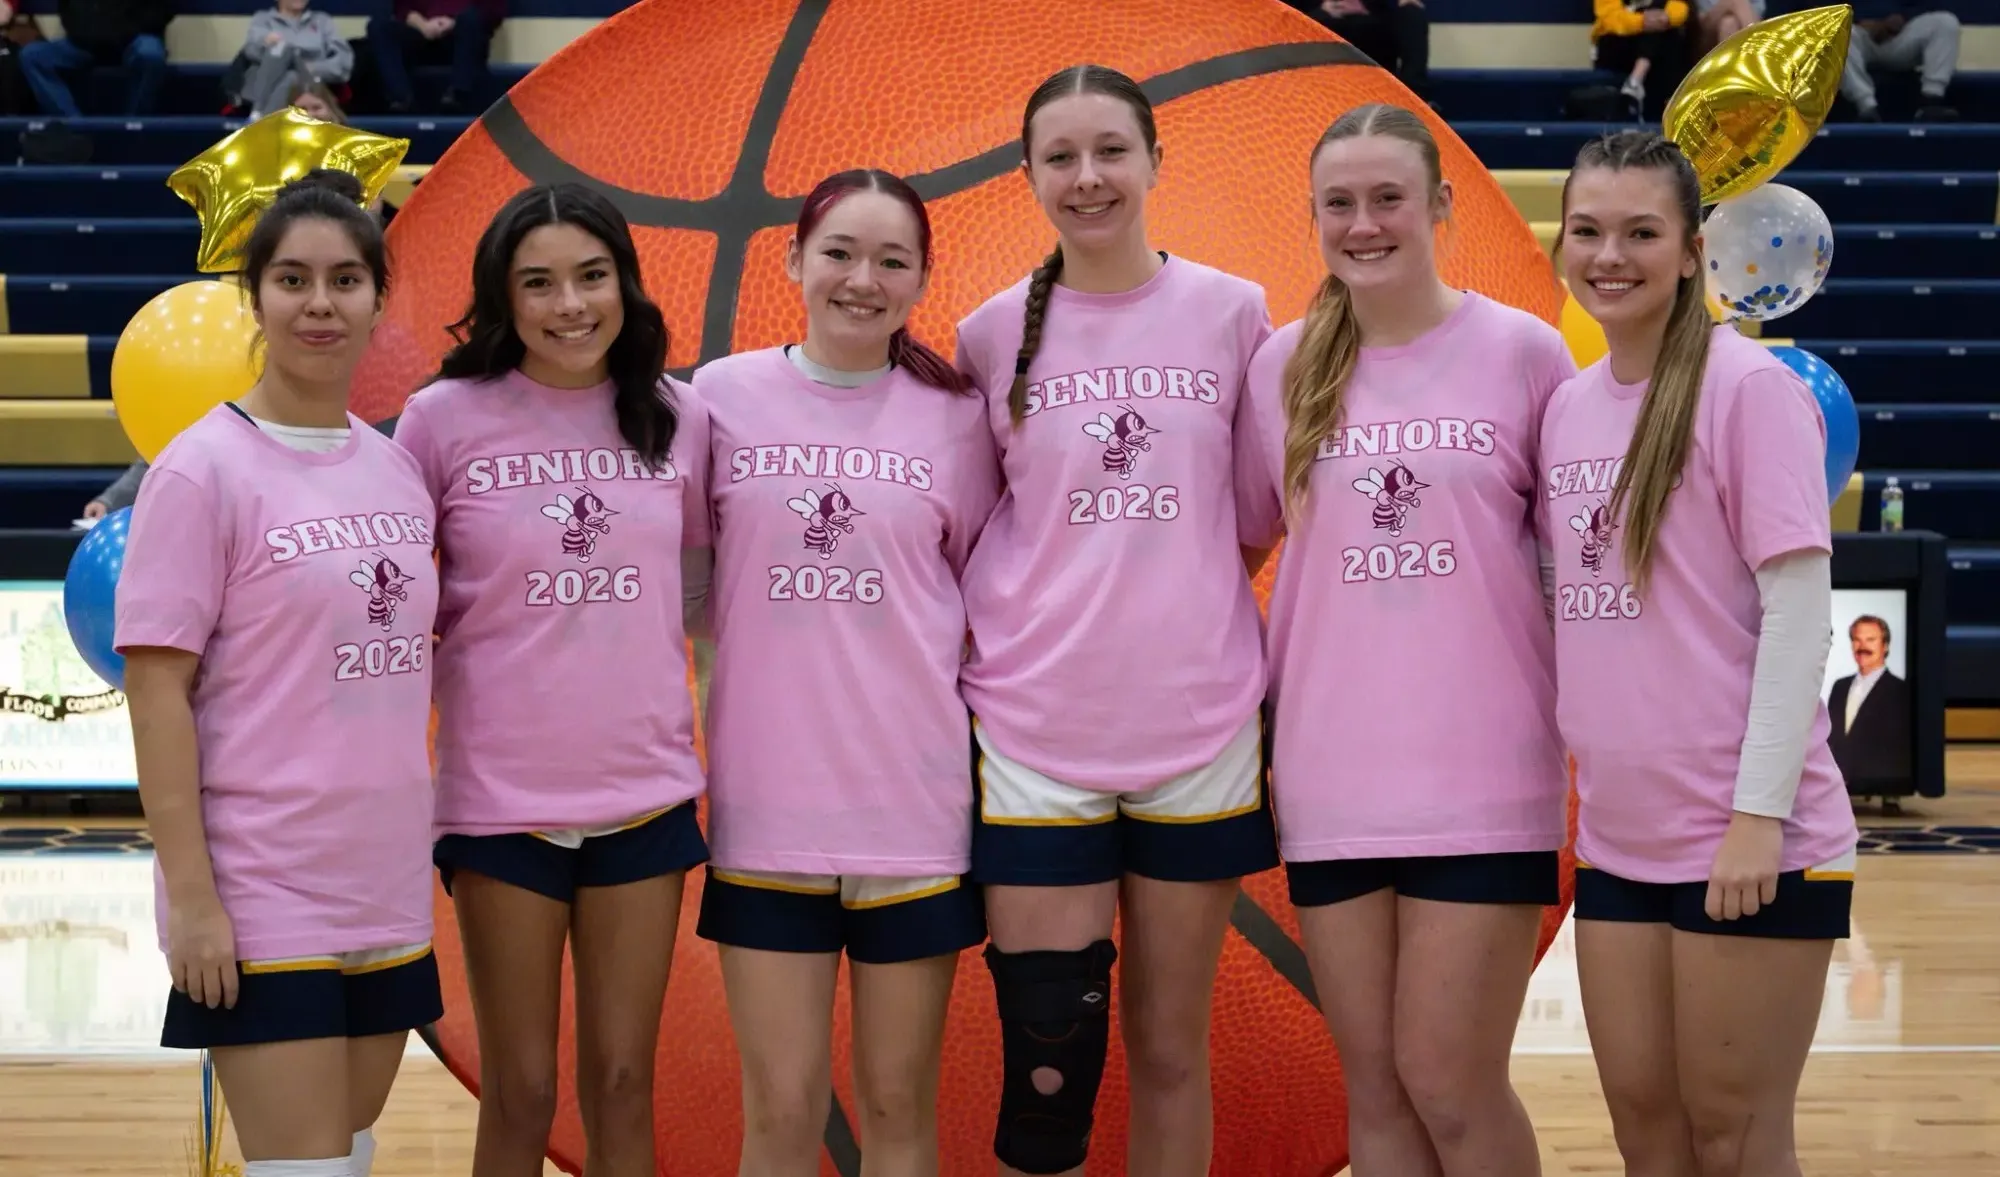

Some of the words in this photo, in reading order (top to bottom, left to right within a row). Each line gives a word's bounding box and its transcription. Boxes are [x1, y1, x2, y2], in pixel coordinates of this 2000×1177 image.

[1023, 366, 1219, 418] SENIORS
[1316, 417, 1496, 461] ENIORS
[731, 444, 933, 491] SENIORS
[1068, 484, 1180, 525] 2026
[264, 511, 434, 563] SENIORS
[1342, 540, 1457, 583] 2026
[525, 565, 641, 606] 2026
[768, 565, 884, 604] 2026
[1560, 582, 1642, 621] 2026
[335, 634, 424, 681] 2026
